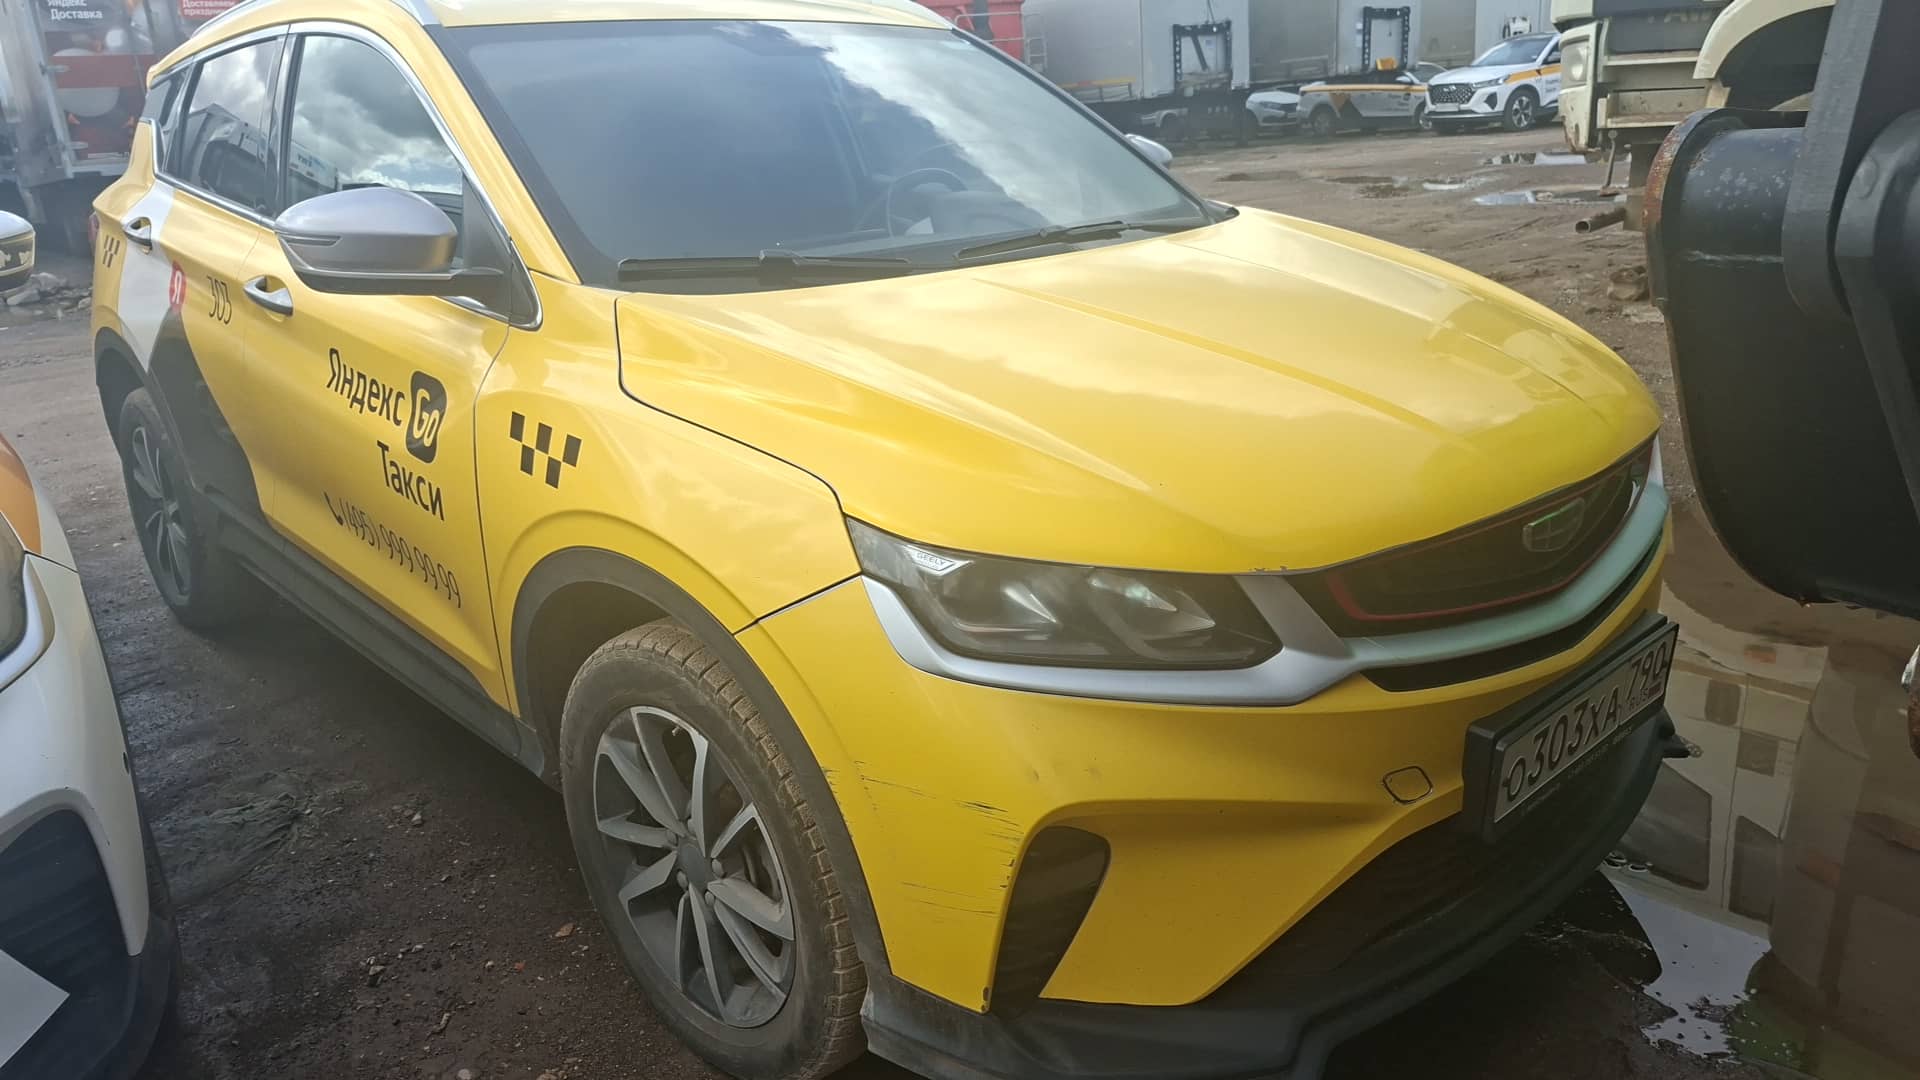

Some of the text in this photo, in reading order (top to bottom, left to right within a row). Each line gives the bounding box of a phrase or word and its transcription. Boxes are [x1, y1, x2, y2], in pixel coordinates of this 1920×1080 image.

[50, 8, 103, 20] Доставка
[172, 269, 182, 304] Я
[206, 275, 232, 325] 303
[326, 348, 440, 447] Яндекс Go
[377, 440, 445, 521] Такси
[339, 498, 462, 608] (495) 999 99 99
[916, 552, 946, 566] GEELY
[1627, 641, 1667, 701] 790
